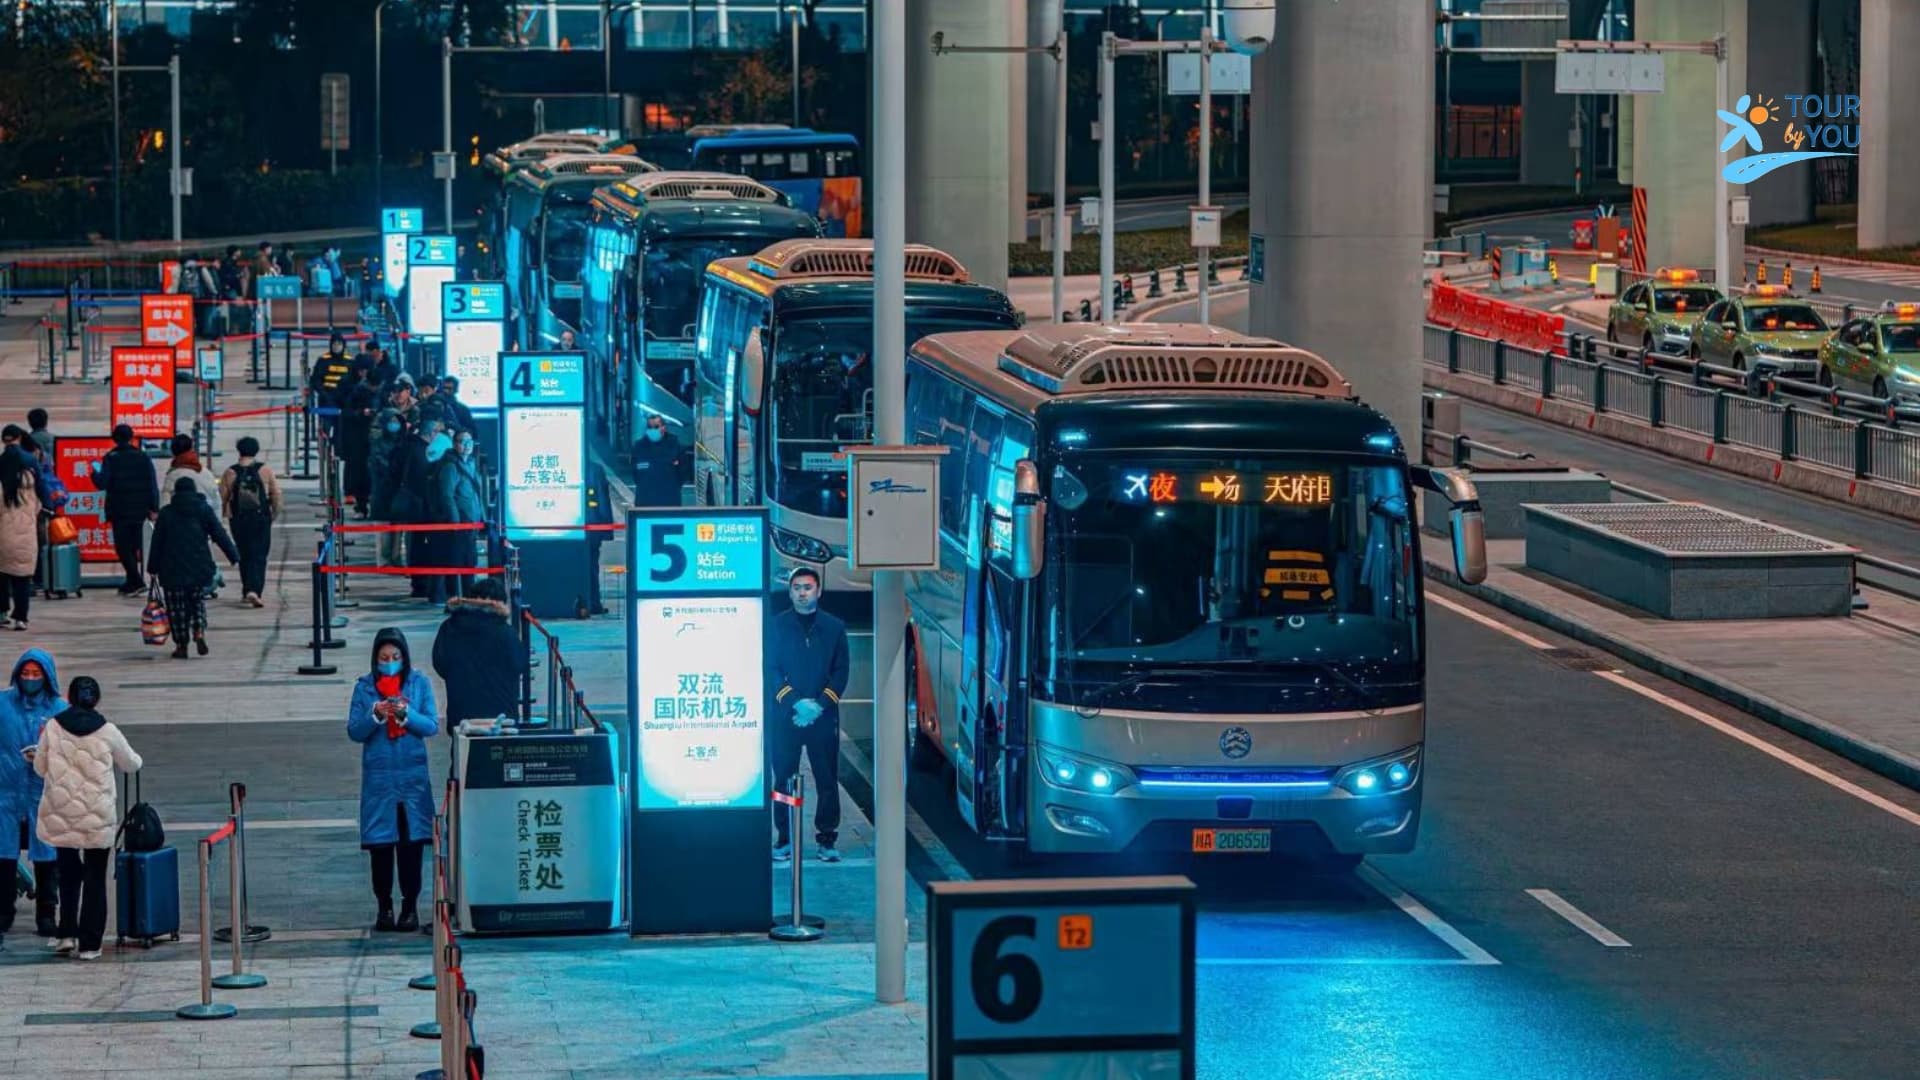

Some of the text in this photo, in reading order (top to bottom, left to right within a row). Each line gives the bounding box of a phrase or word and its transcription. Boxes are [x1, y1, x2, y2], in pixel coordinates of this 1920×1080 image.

[390, 213, 396, 229] 1
[414, 240, 427, 260] 2
[450, 287, 467, 314] 3
[510, 361, 535, 397] 4
[530, 455, 559, 469] 成都
[523, 469, 567, 484] 东客站
[1149, 473, 1177, 501] 夜
[650, 523, 688, 583] 5
[697, 552, 727, 567] 站台
[697, 568, 736, 580] Station
[678, 672, 724, 695] 双流
[654, 696, 748, 720] 国际机场
[731, 719, 758, 729] Airport
[684, 745, 718, 758] 上客点
[517, 800, 532, 891] Check Ticket
[533, 799, 565, 891] 检票处
[1064, 927, 1087, 945] T2
[970, 914, 1043, 1024] 6
